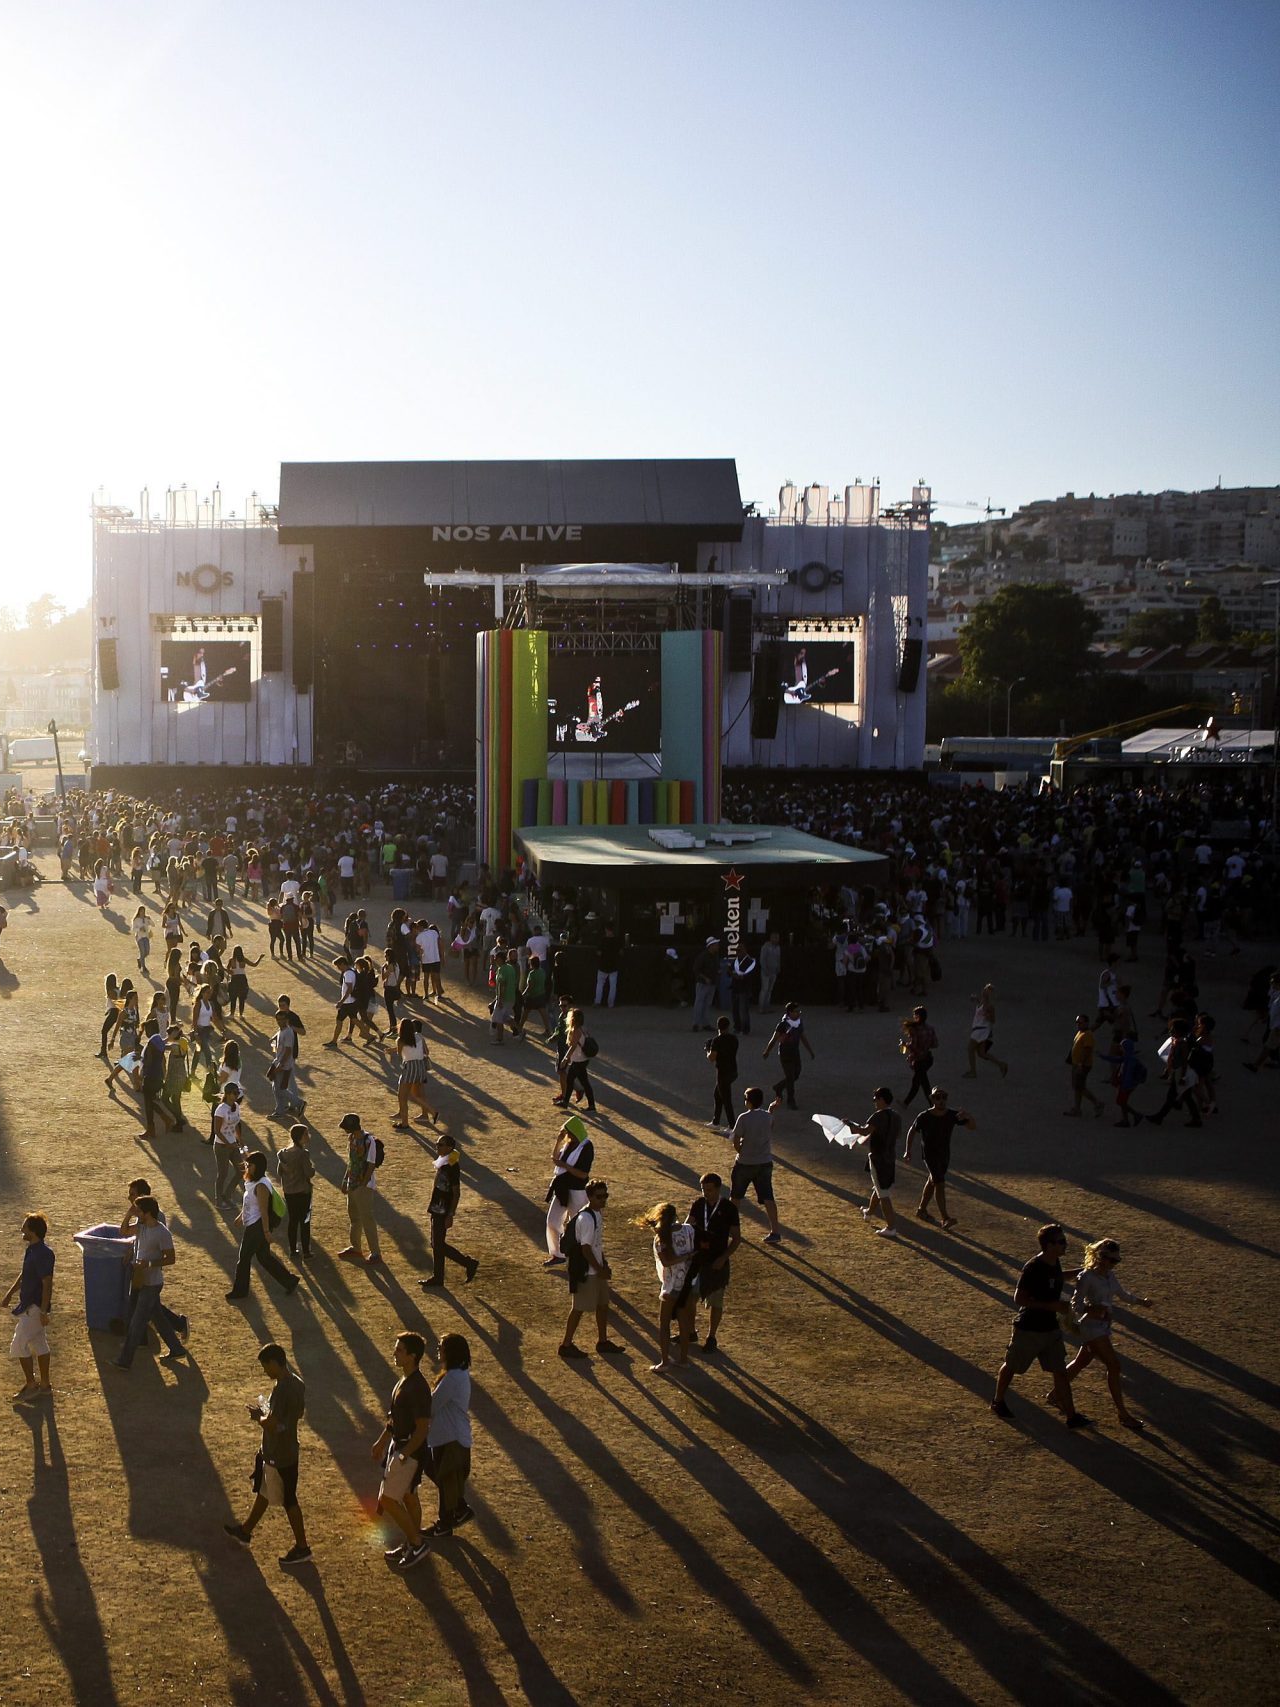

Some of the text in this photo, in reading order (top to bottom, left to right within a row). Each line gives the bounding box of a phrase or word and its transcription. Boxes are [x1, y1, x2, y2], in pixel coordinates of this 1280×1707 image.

[432, 525, 583, 542] NOS ALIVE
[176, 563, 234, 595] NOS
[723, 896, 740, 960] ineken
